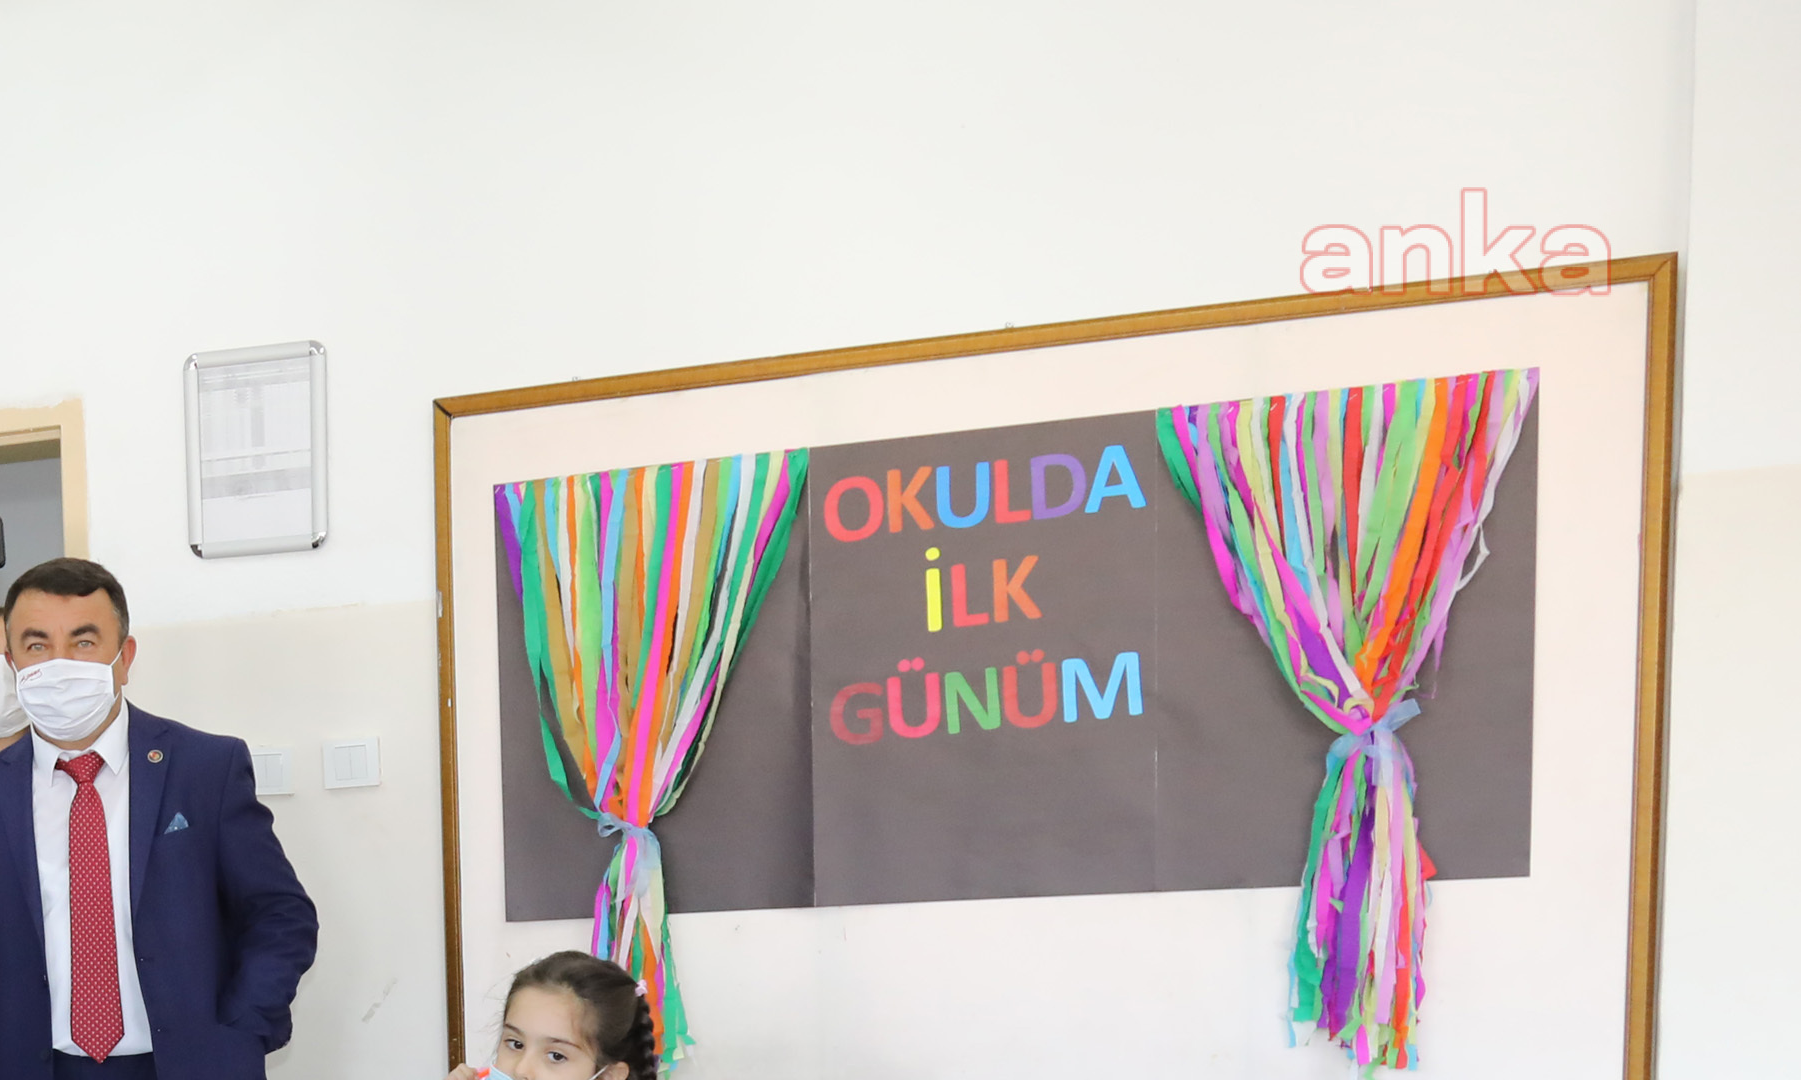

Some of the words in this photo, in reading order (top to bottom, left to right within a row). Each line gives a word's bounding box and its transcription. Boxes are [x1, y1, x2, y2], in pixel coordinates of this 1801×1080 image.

[823, 444, 1147, 542] OKULDA
[925, 547, 1043, 632] İLK
[829, 649, 1143, 745] GÜNÜM
